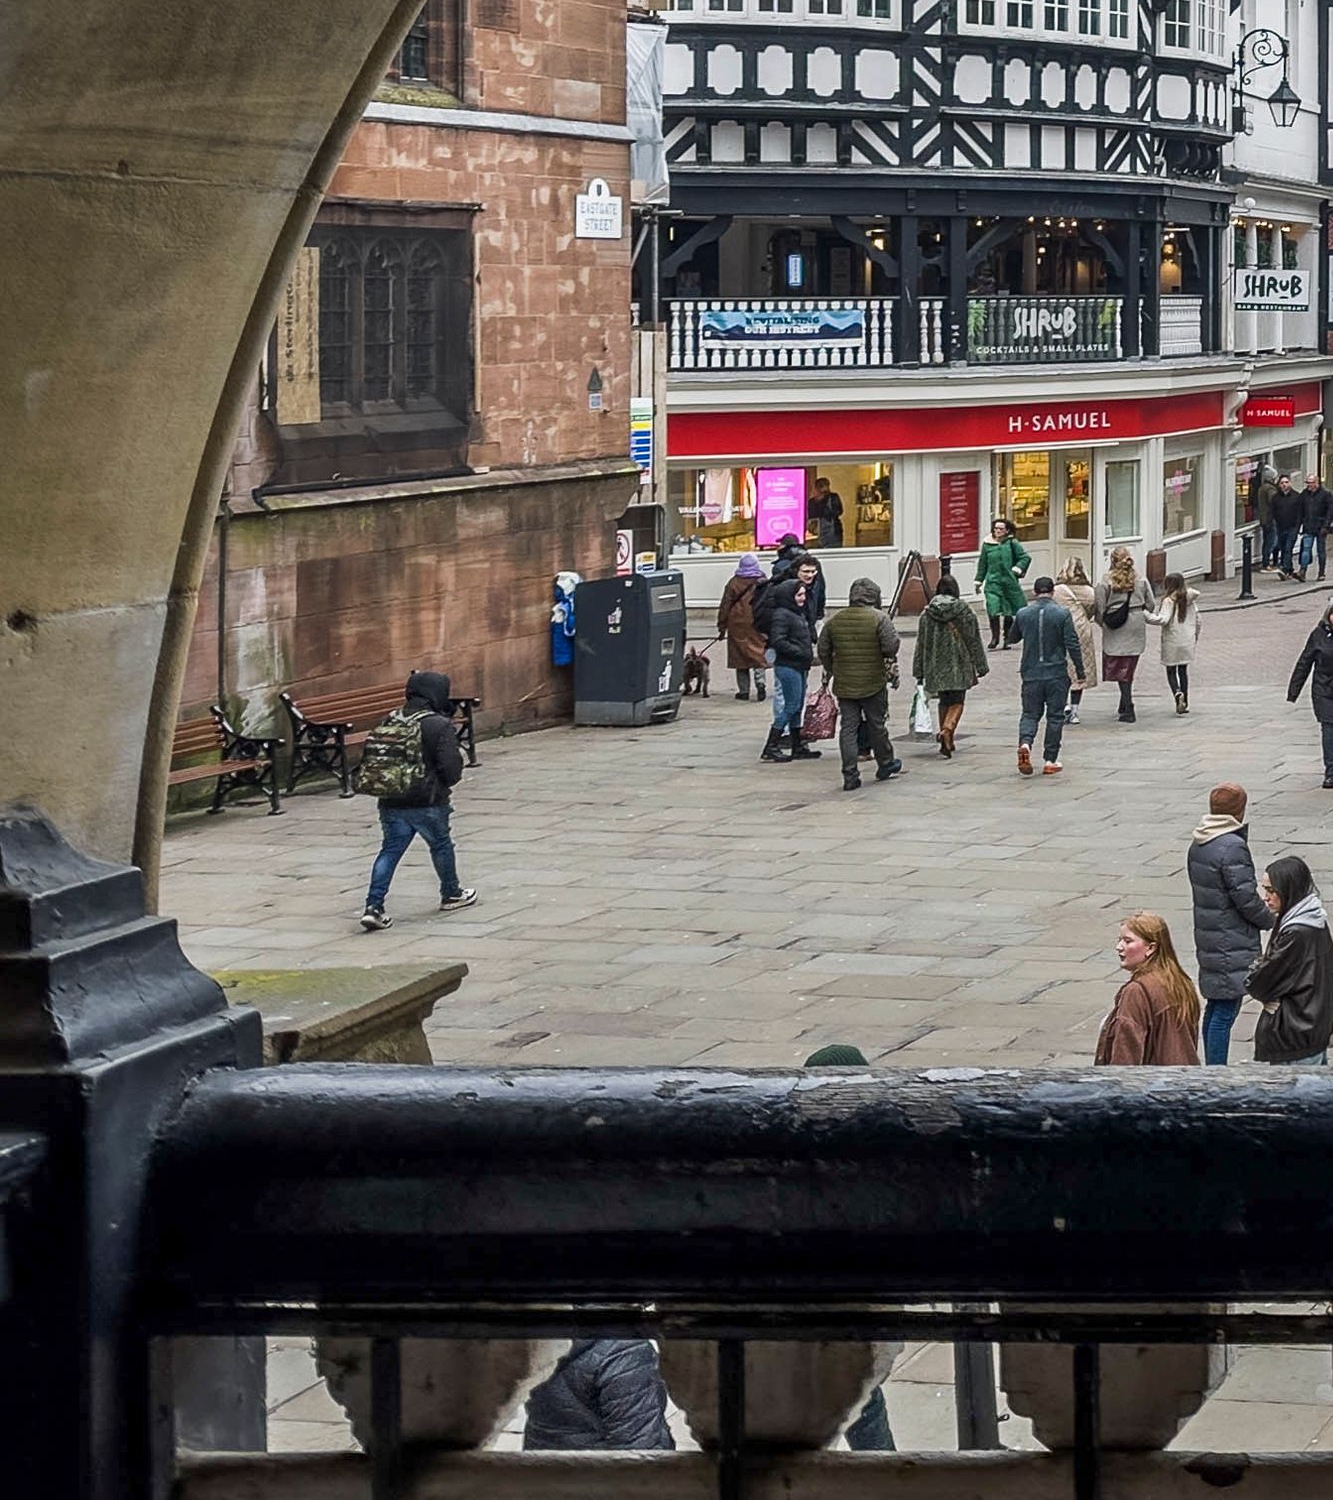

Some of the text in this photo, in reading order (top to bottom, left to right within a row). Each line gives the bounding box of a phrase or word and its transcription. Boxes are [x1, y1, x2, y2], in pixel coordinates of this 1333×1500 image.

[1013, 307, 1077, 339] SHRUB
[976, 345, 1029, 354] COCKTAILS
[1042, 344, 1073, 353] SMALL
[1076, 344, 1109, 352] PLATES
[1256, 409, 1291, 417] SAMUEL
